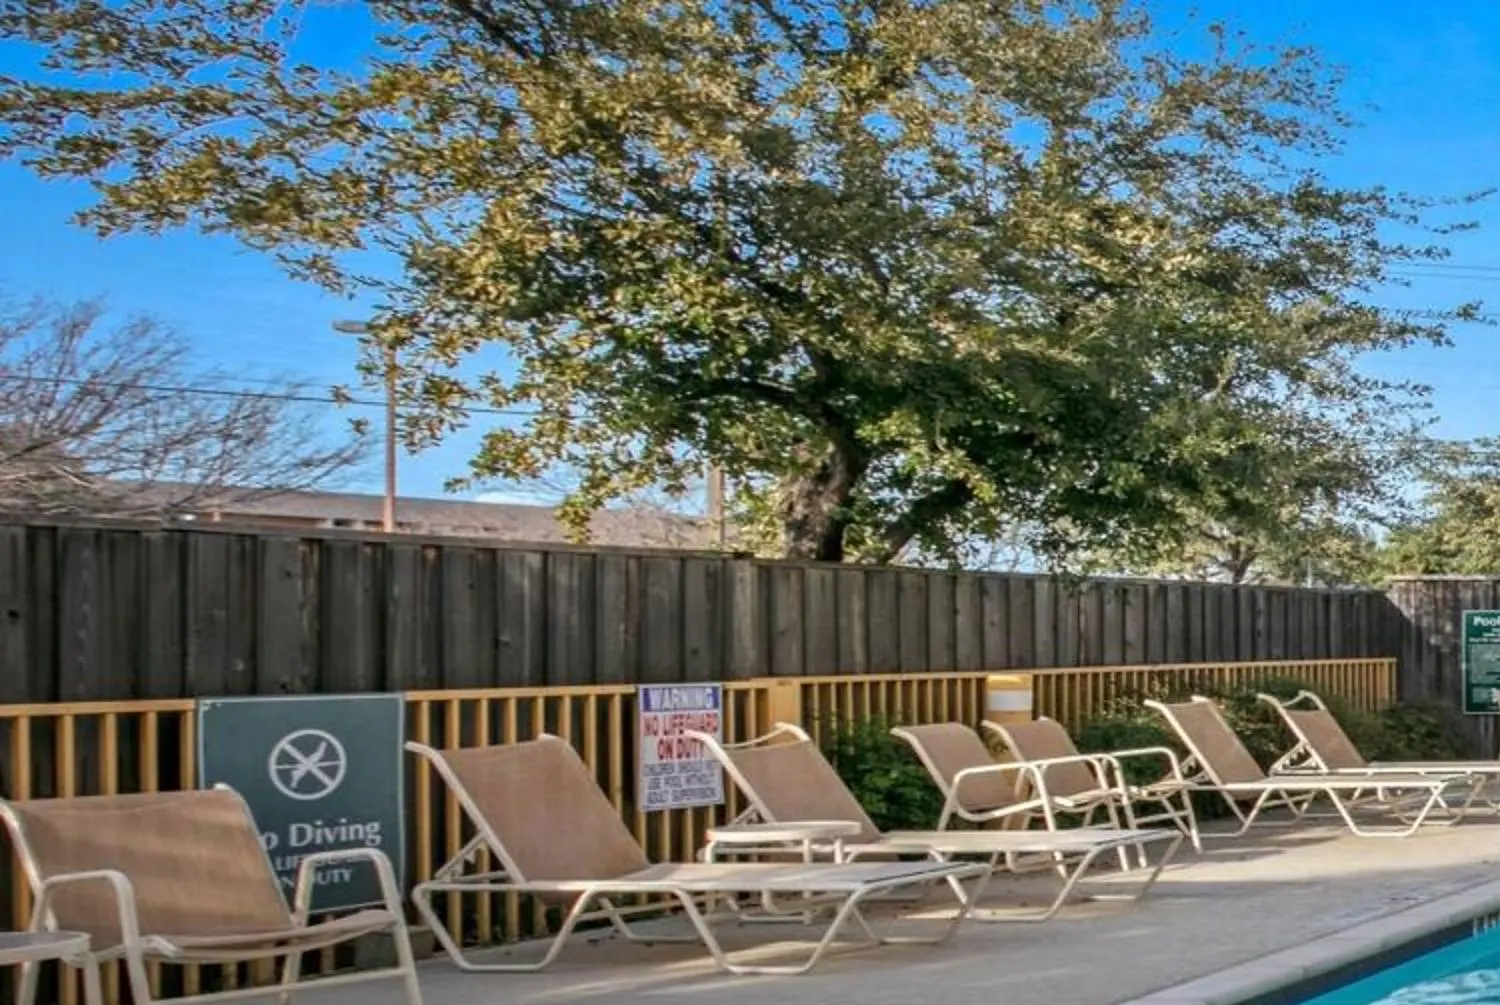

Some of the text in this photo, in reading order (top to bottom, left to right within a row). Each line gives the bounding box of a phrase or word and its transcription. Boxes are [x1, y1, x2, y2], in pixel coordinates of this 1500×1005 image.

[1473, 615, 1500, 627] Pool
[649, 688, 713, 711] WARNING
[643, 712, 718, 736] NO LIFEGUARD
[658, 737, 705, 760] ON DUTY
[259, 818, 382, 849] o Diving
[316, 868, 352, 885] UTY
